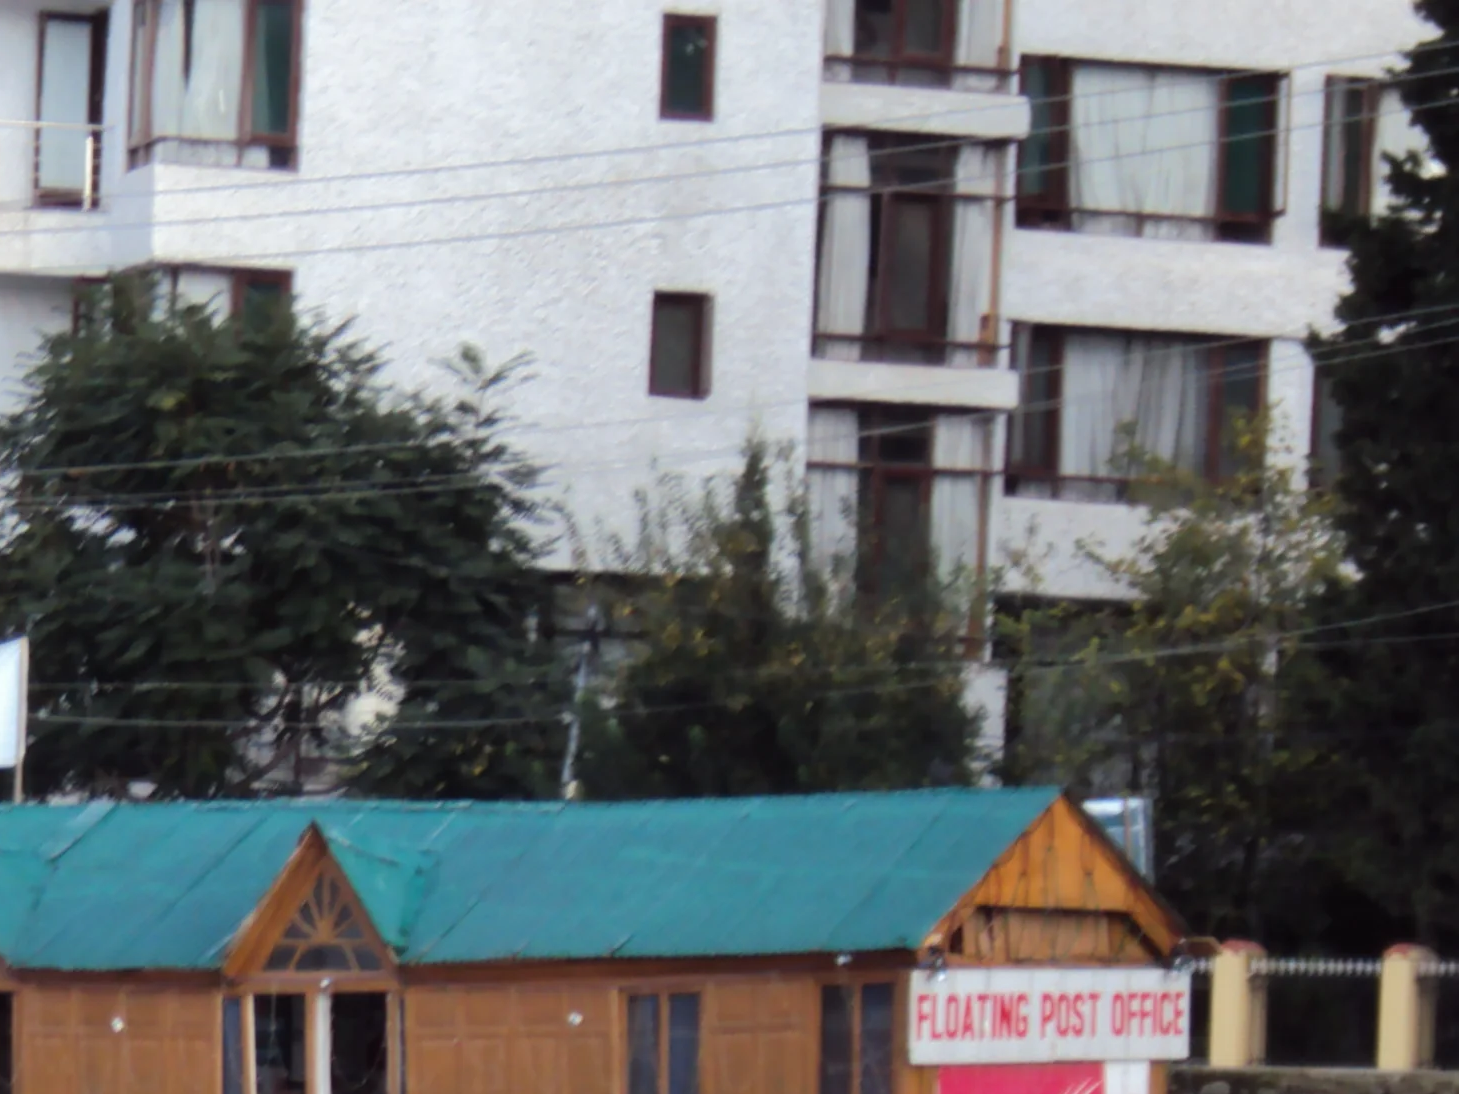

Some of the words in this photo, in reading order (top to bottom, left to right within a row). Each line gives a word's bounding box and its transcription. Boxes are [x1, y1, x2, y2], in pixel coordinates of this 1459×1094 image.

[916, 993, 1029, 1040] FLOATING
[1039, 993, 1100, 1037] POST
[1110, 991, 1185, 1036] OFFICE
